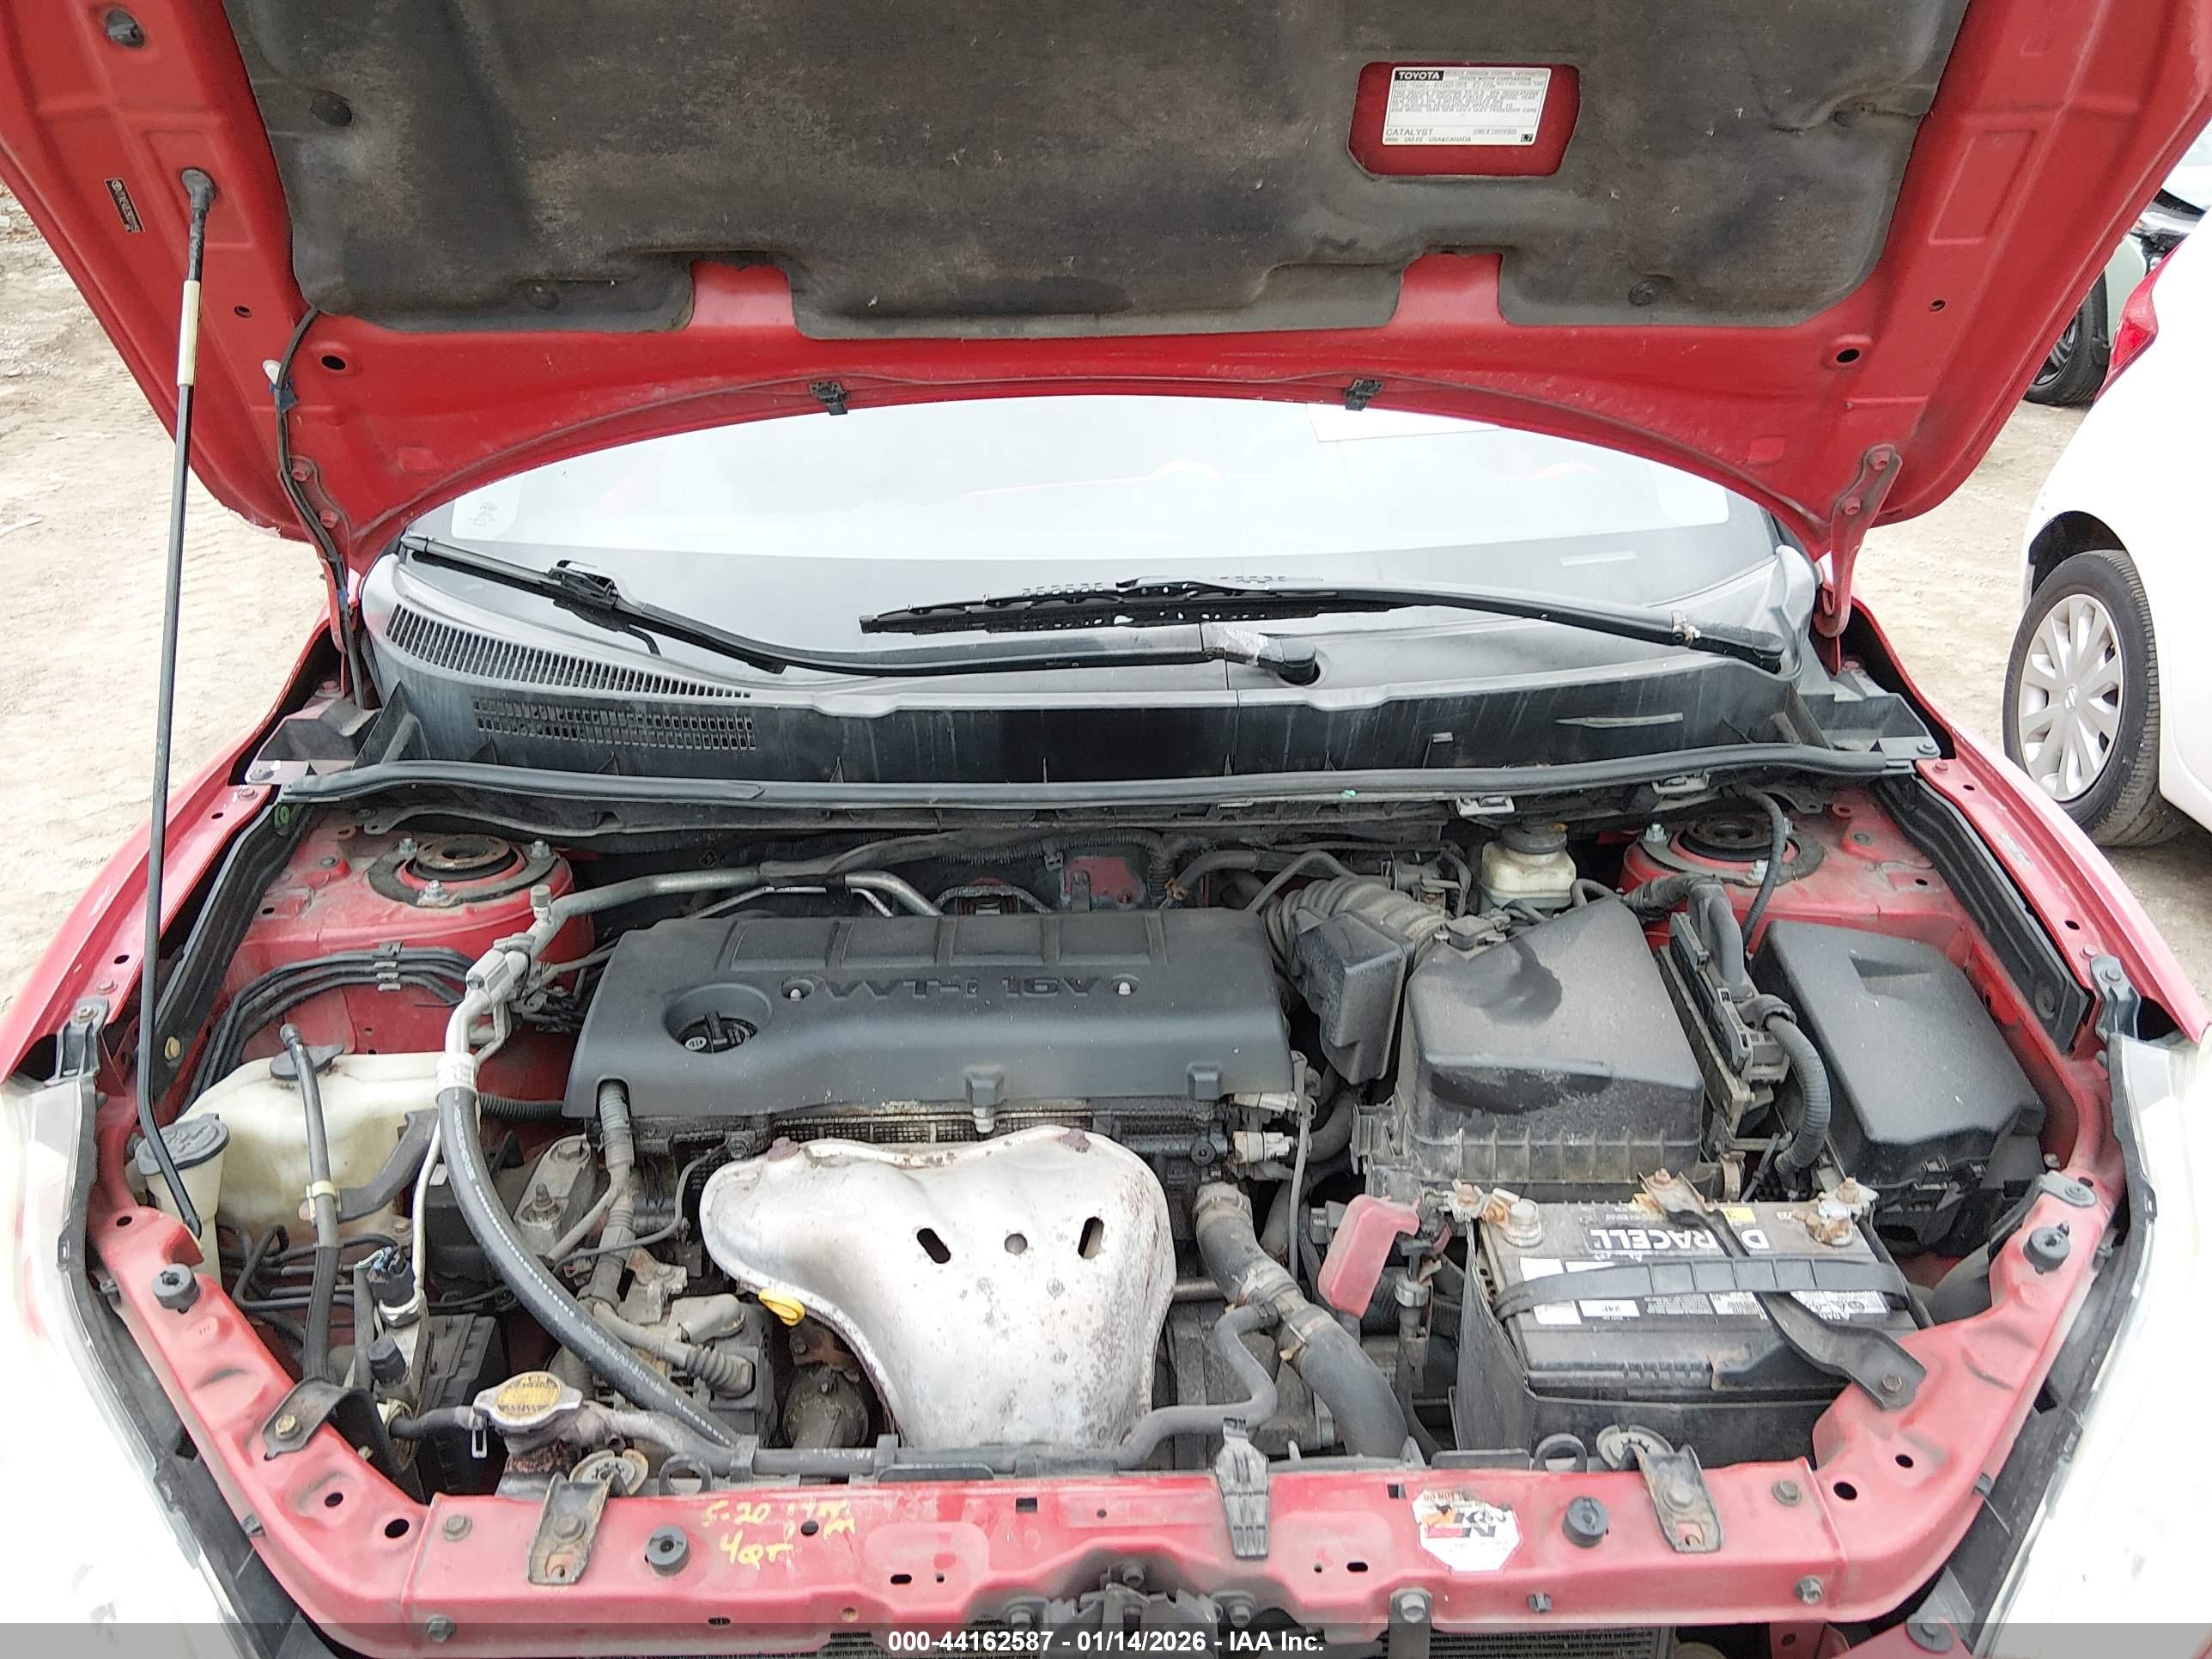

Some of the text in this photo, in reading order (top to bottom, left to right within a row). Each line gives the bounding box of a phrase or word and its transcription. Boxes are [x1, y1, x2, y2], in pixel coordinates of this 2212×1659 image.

[1398, 71, 1440, 80] TOYOTA
[1002, 977, 1102, 999] 16V
[1589, 1229, 1770, 1250] DRACELL
[702, 1500, 771, 1527] 5-20
